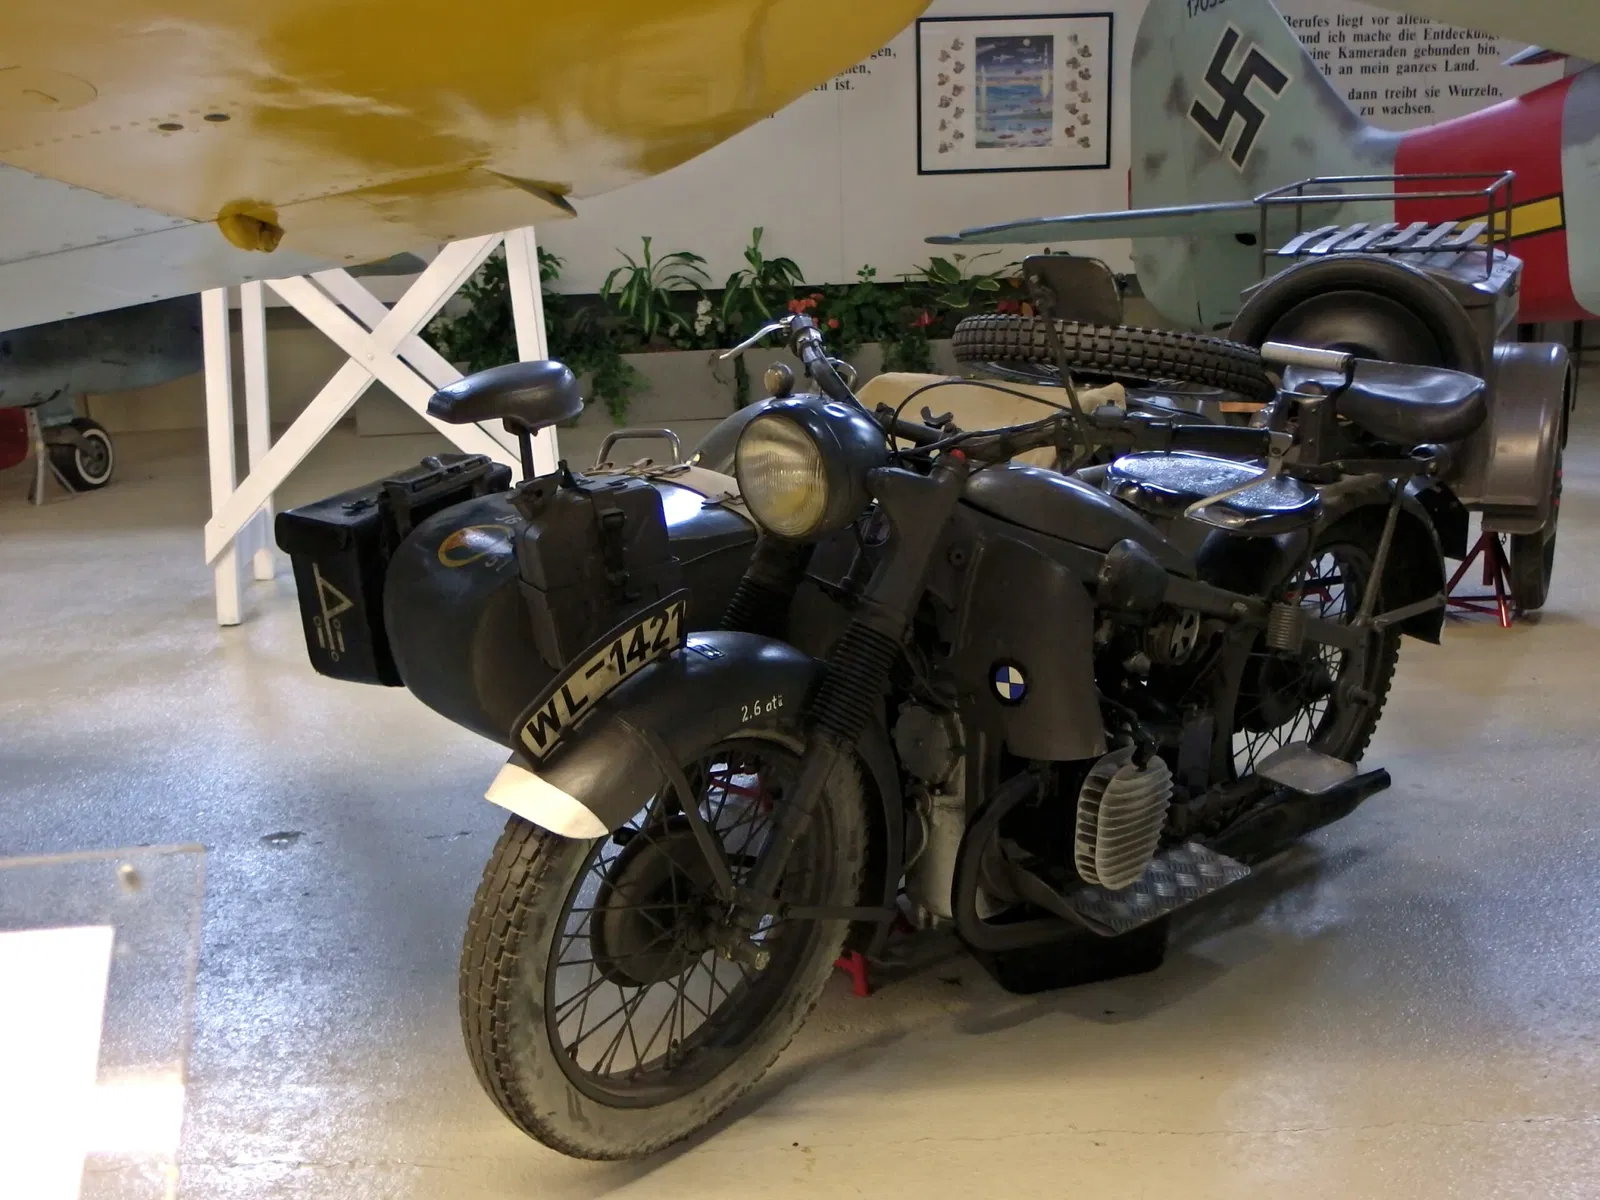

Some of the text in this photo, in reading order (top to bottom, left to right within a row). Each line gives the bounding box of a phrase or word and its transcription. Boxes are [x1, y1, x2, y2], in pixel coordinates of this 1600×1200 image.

[1336, 14, 1363, 28] liegt
[1371, 16, 1390, 26] vor
[1328, 30, 1346, 43] ich
[1352, 30, 1391, 42] mache
[1398, 28, 1416, 41] die
[1338, 44, 1406, 59] Kameraden
[1414, 43, 1470, 59] gebunden
[1339, 65, 1352, 75] an
[1360, 63, 1389, 74] mein
[1396, 62, 1437, 75] ganzes
[1348, 88, 1377, 101] dann
[1385, 86, 1417, 99] treibt
[1424, 86, 1440, 98] sie
[1360, 105, 1374, 116] zu
[741, 700, 761, 723] 2.6
